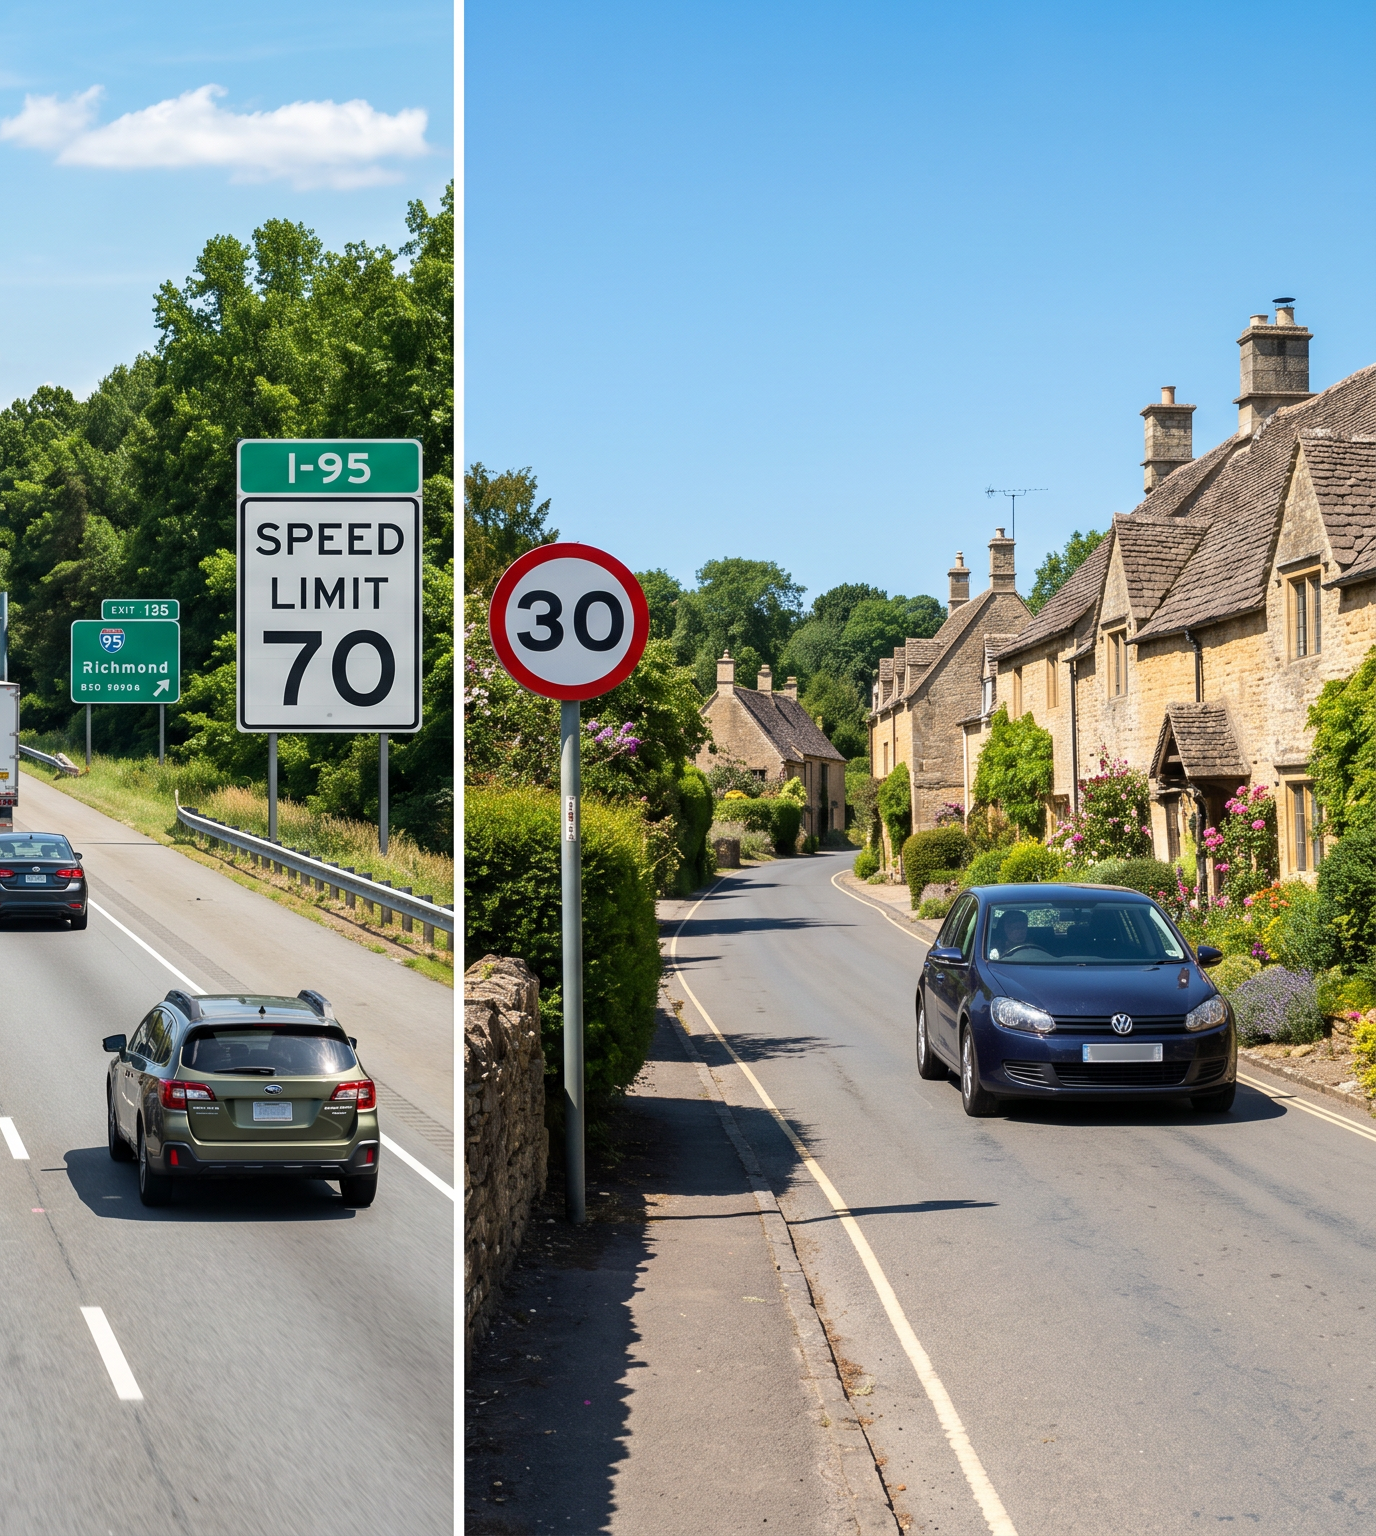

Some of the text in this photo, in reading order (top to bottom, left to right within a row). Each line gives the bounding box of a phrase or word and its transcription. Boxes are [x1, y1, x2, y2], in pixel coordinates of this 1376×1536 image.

[288, 452, 372, 484] I-95
[256, 522, 405, 556] SPEED
[271, 577, 389, 610] LIMIT
[111, 604, 169, 616] EXIT 135
[516, 590, 625, 652] 30
[102, 635, 122, 649] 95
[82, 661, 168, 674] Richmond
[262, 629, 396, 707] 70
